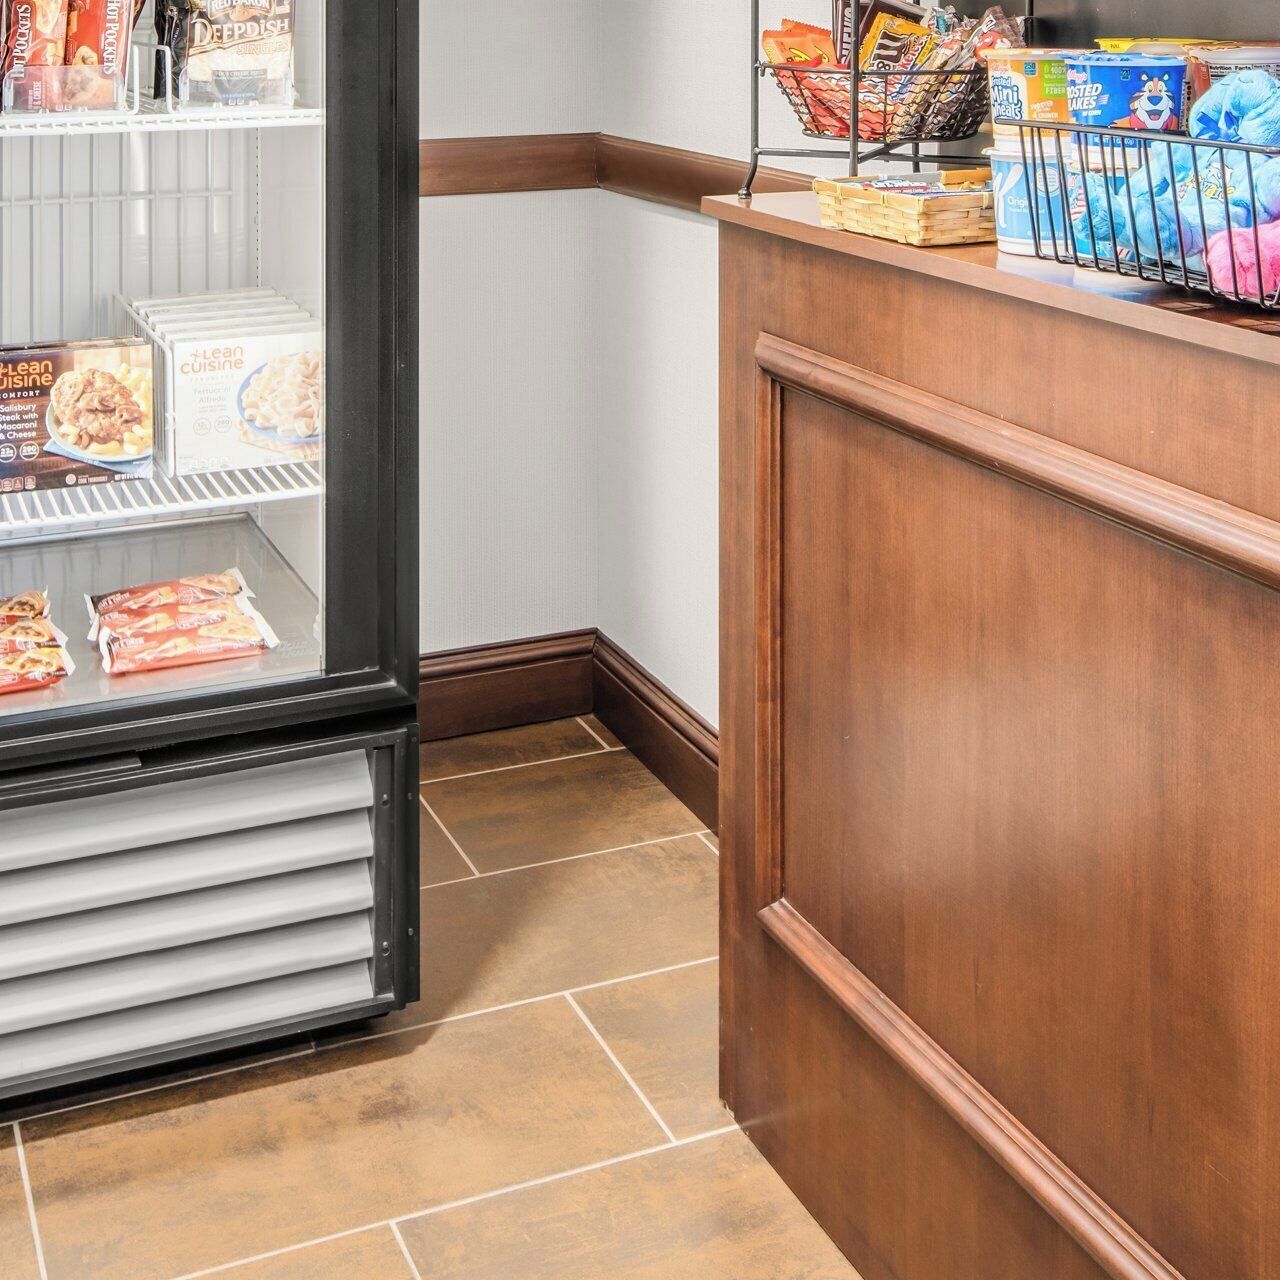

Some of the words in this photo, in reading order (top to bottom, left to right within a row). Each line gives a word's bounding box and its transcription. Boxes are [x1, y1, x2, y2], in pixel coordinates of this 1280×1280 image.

[992, 85, 1018, 104] Mini
[0, 403, 36, 414] Salisbury
[0, 421, 37, 431] Macaroni
[8, 430, 37, 438] Cheese
